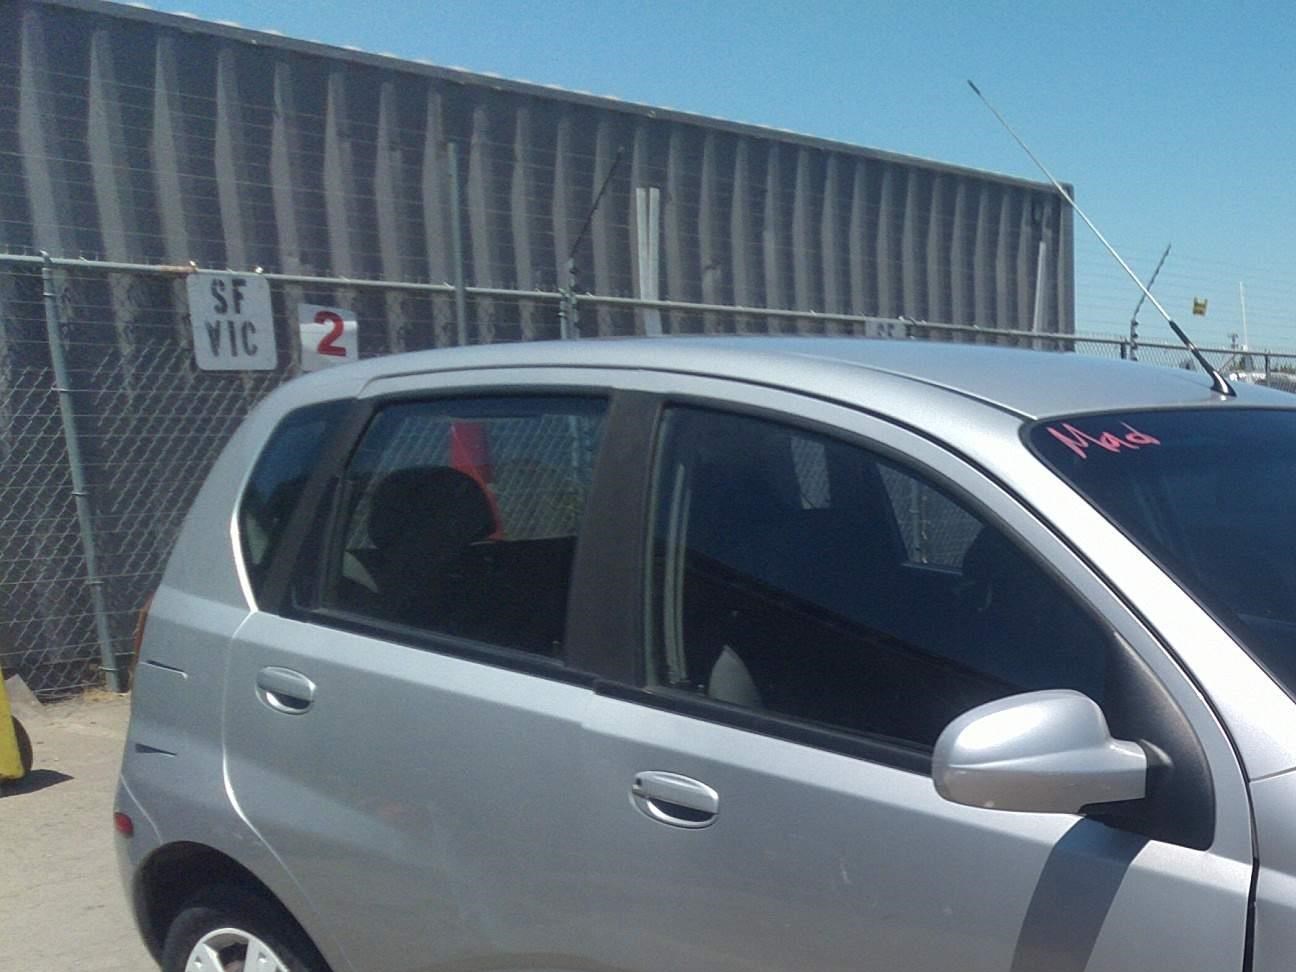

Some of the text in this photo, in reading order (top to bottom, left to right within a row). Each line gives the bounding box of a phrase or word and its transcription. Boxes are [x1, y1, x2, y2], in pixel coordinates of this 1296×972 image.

[210, 278, 247, 315] SF
[205, 320, 258, 357] VIC
[313, 310, 347, 357] 2
